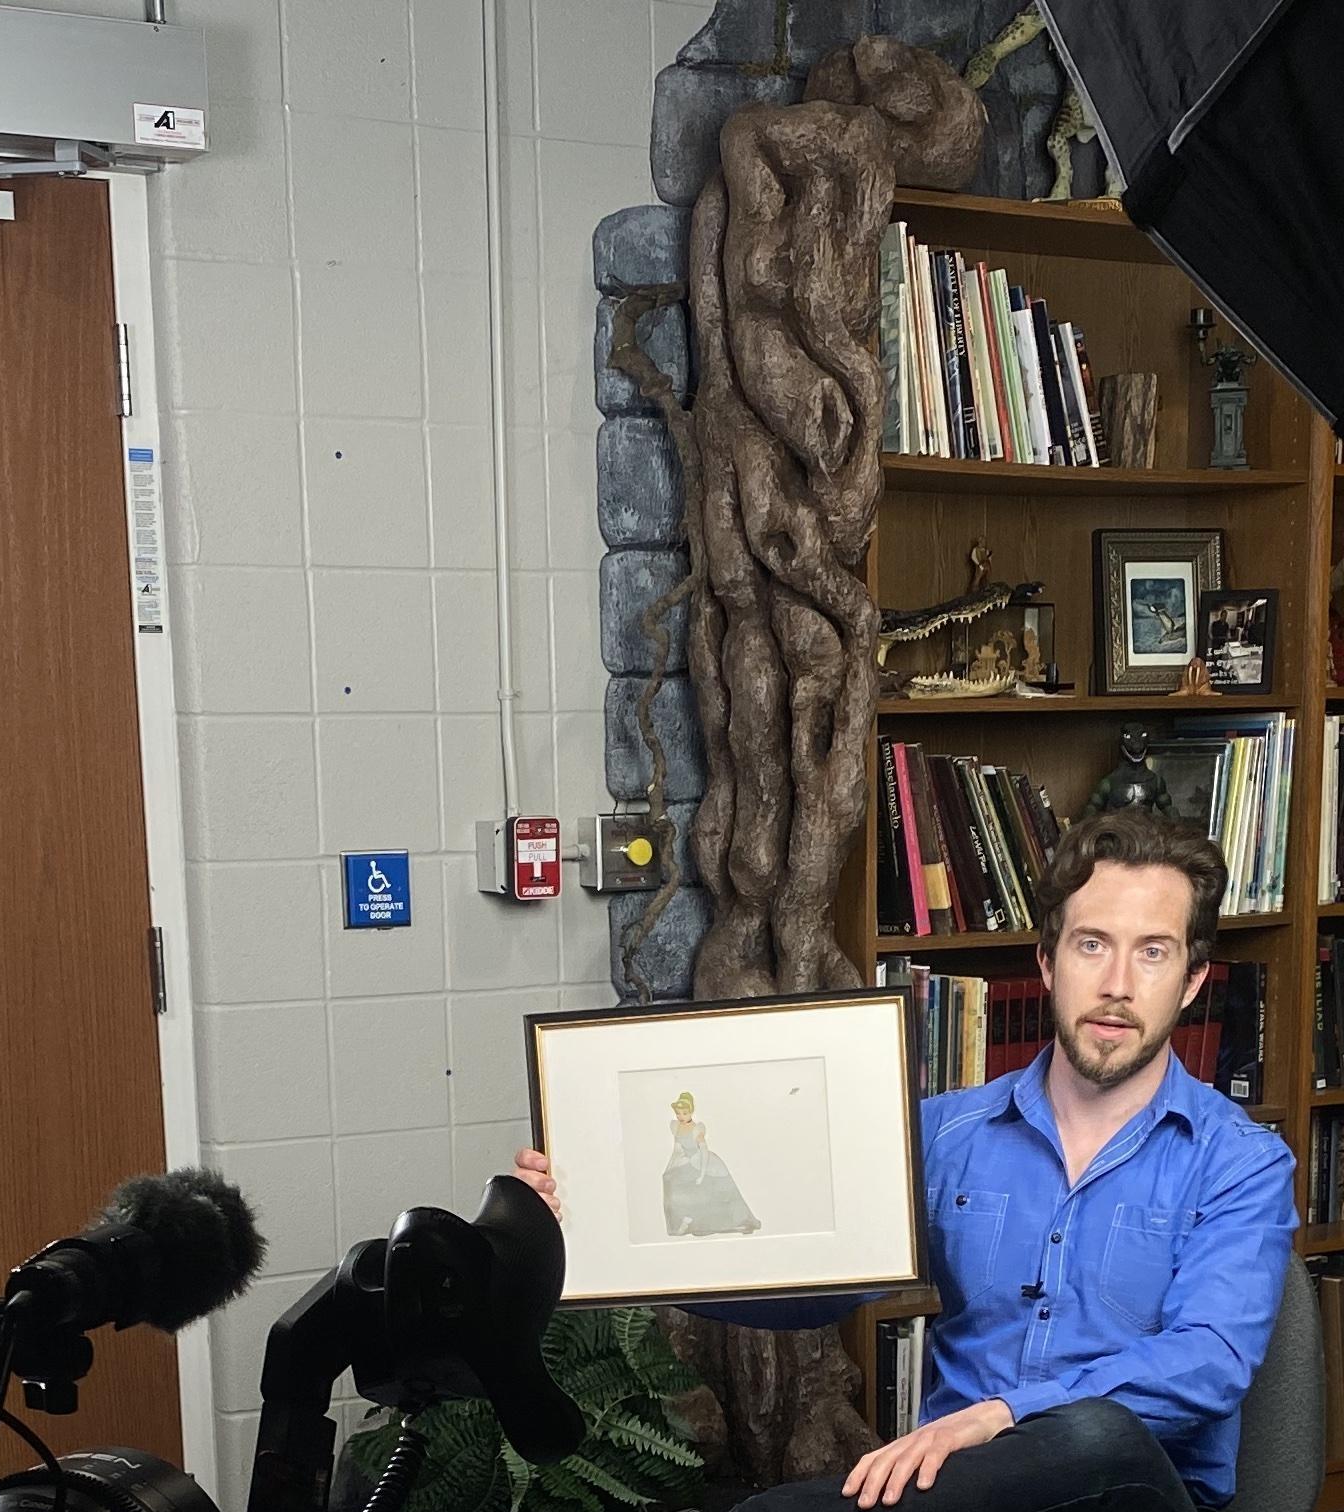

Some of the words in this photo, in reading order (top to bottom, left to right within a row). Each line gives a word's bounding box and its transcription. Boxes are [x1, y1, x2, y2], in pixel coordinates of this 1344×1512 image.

[882, 742, 902, 830] michelangelo
[527, 842, 547, 850] PUSH
[528, 852, 547, 861] PULL
[368, 894, 392, 902] PRESS
[358, 903, 370, 911] TO
[370, 902, 404, 911] OPERATE
[369, 911, 392, 920] DOOR
[1316, 993, 1324, 1031] ILIAD
